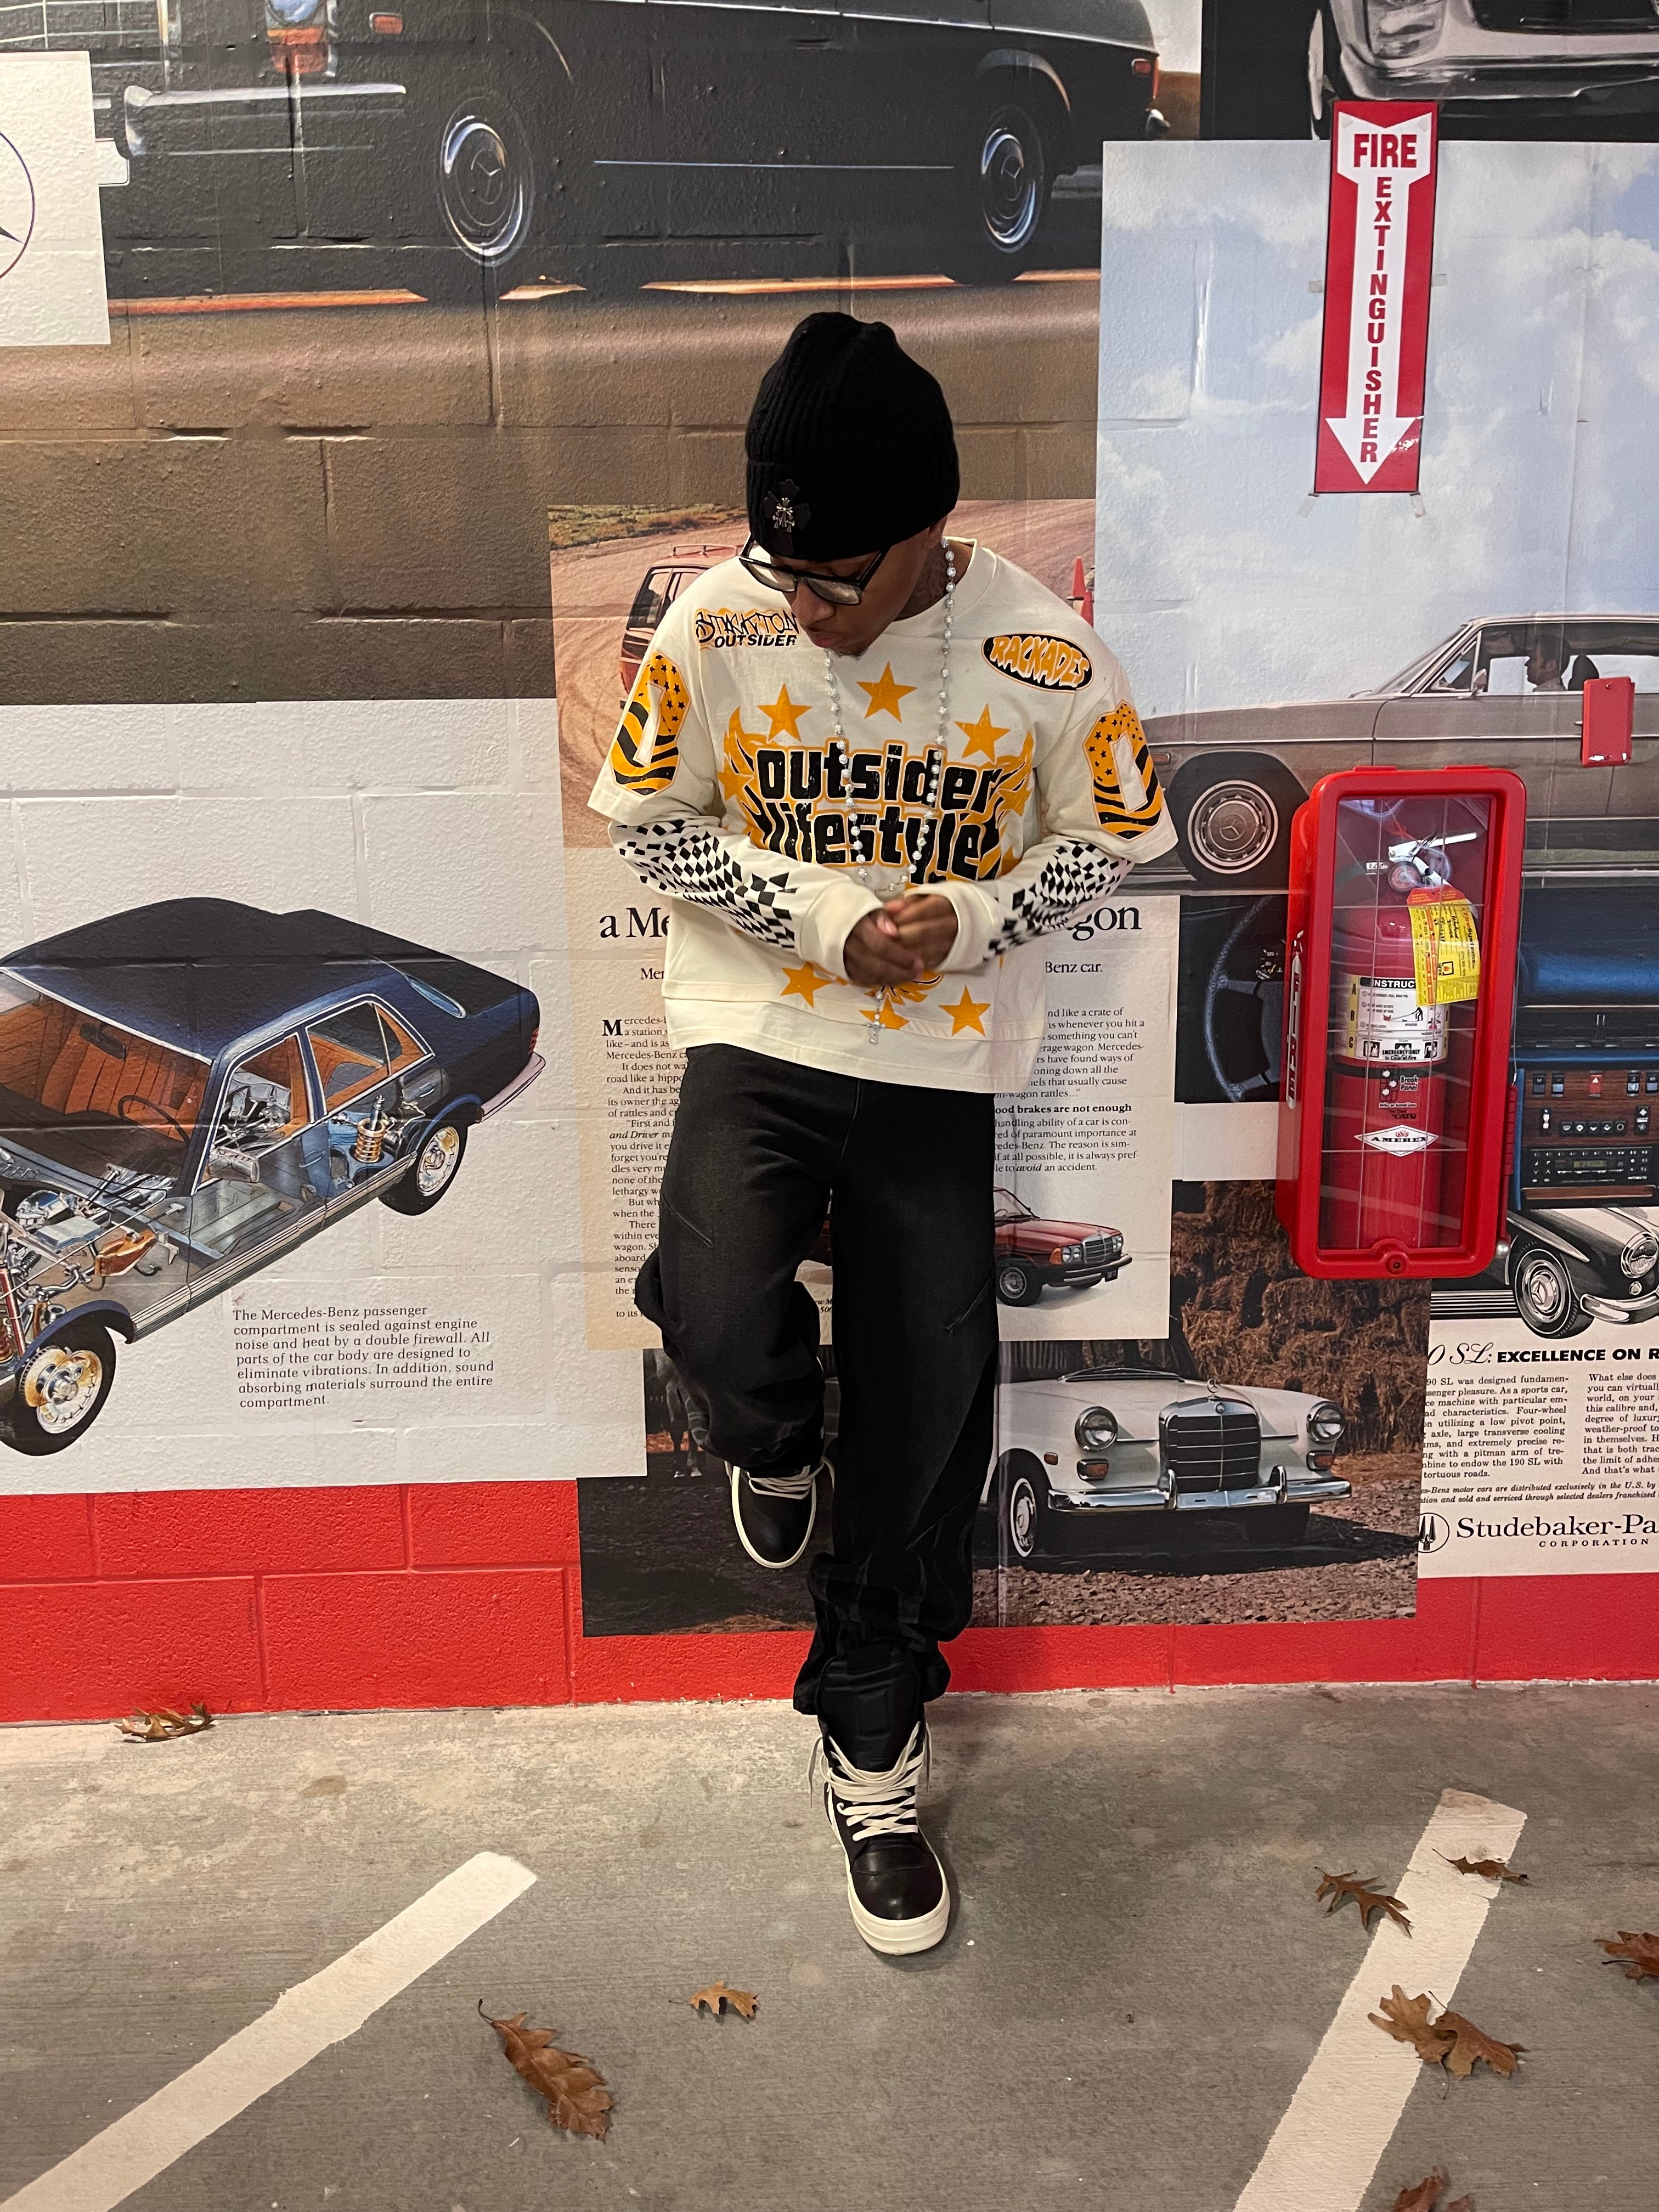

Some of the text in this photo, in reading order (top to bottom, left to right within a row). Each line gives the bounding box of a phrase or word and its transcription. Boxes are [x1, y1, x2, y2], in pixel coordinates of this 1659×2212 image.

[1353, 133, 1417, 168] FIRE
[1360, 176, 1392, 463] EXTINGUISHER
[714, 634, 798, 648] OUTSIDER
[755, 741, 1003, 814] outsider
[599, 907, 670, 939] a Me
[1066, 907, 1142, 941] gon
[1080, 963, 1103, 973] car.
[1373, 979, 1415, 989] NSTRUC
[1048, 1009, 1059, 1017] nd
[1062, 1008, 1079, 1017] like
[1114, 1007, 1124, 1015] of
[1047, 1031, 1096, 1041] something
[1118, 1030, 1137, 1039] can't
[607, 1051, 677, 1059] Mercedes-Benz
[1124, 1053, 1134, 1062] of
[1063, 1066, 1088, 1074] down
[1091, 1065, 1101, 1074] all
[607, 1074, 628, 1082] road
[623, 1086, 641, 1094] And
[651, 1086, 667, 1094] has
[670, 1086, 681, 1094] be
[652, 1097, 667, 1105] the
[669, 1098, 679, 1107] ag
[995, 1105, 1014, 1114] ood
[1018, 1105, 1051, 1113] brakes
[1093, 1104, 1132, 1113] enough
[1037, 1118, 1064, 1128] ability
[629, 1220, 656, 1228] There
[614, 1254, 646, 1262] aboard
[233, 1307, 427, 1321] The Mercedes-Benz passenger
[234, 1319, 477, 1338] compartment is sealed against engine
[236, 1340, 268, 1350] noise
[273, 1338, 297, 1349] and
[303, 1338, 329, 1348] heat
[335, 1335, 349, 1348] by
[366, 1334, 409, 1345] double
[413, 1332, 466, 1346] firewall.
[471, 1332, 489, 1342] All
[237, 1355, 268, 1367] parts
[273, 1353, 285, 1365] of
[290, 1353, 309, 1363] the
[338, 1350, 369, 1362] body
[398, 1347, 454, 1361] designed
[460, 1348, 470, 1357] to
[1497, 1349, 1606, 1363] EXCELLENCE
[1612, 1348, 1641, 1361] ON
[238, 1361, 493, 1379] eliminate vibrations. In addition, sound
[1479, 1376, 1516, 1385] designed
[1521, 1375, 1568, 1383] fundamen-
[239, 1376, 492, 1395] absorbing materials surround the entire
[240, 1395, 329, 1409] compartment.
[1587, 1394, 1615, 1402] world,
[1639, 1403, 1657, 1412] and,
[1585, 1424, 1647, 1434] weather-proof
[1457, 1514, 1659, 1538] Studebaker-Pa
[1539, 1539, 1649, 1547] CORPORATION
